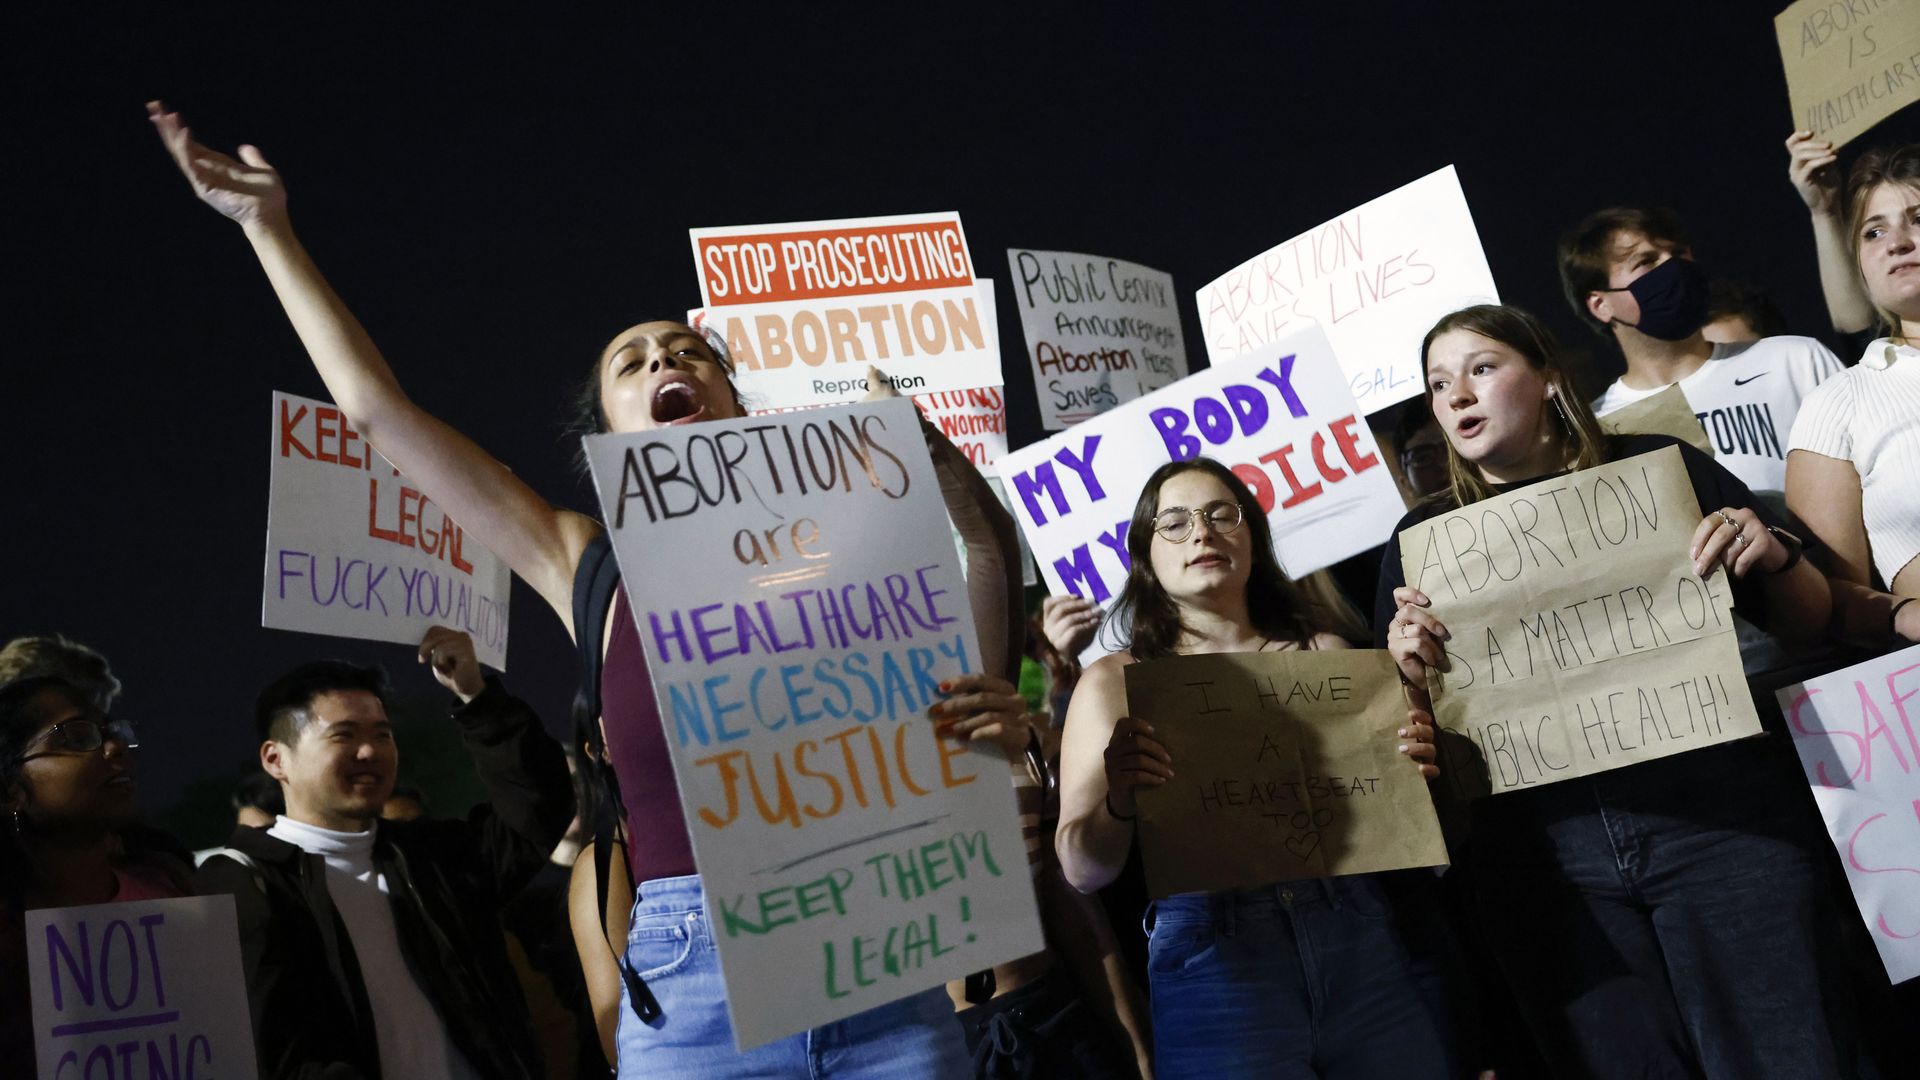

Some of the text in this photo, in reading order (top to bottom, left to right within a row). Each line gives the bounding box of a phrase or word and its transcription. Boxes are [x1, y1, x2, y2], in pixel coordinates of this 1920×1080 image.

[1848, 25, 1877, 69] IS
[705, 228, 968, 298] STOP PROSECUTING
[1016, 251, 1106, 309] Public
[1207, 213, 1364, 339] ABORTION
[1330, 249, 1436, 324] LIVES
[726, 297, 986, 372] ABORTION
[1048, 379, 1119, 411] Saves
[615, 413, 911, 530] ABORTIONS
[1011, 353, 1310, 528] MY BODY
[368, 478, 474, 576] LEGAL
[732, 516, 828, 566] are
[1053, 518, 1132, 606] MY
[1417, 466, 1659, 602] ABORTION
[278, 549, 389, 618] FUCK
[398, 565, 453, 620] YOU
[646, 563, 960, 666] HEALTHCARE
[1486, 625, 1515, 685] A
[1519, 584, 1672, 678] MATTER
[1677, 568, 1722, 631] OF
[666, 633, 973, 749] NECESSARY
[1185, 675, 1352, 715] I HAVE
[694, 715, 979, 830] JUSTICE
[1257, 733, 1281, 763] A
[1440, 673, 1732, 799] PUBLIC HEALTH!
[1199, 775, 1381, 813] HEARTBEAT
[1261, 806, 1334, 830] TOO
[717, 829, 1005, 940] KEEP THEM
[45, 913, 166, 1012] NOT
